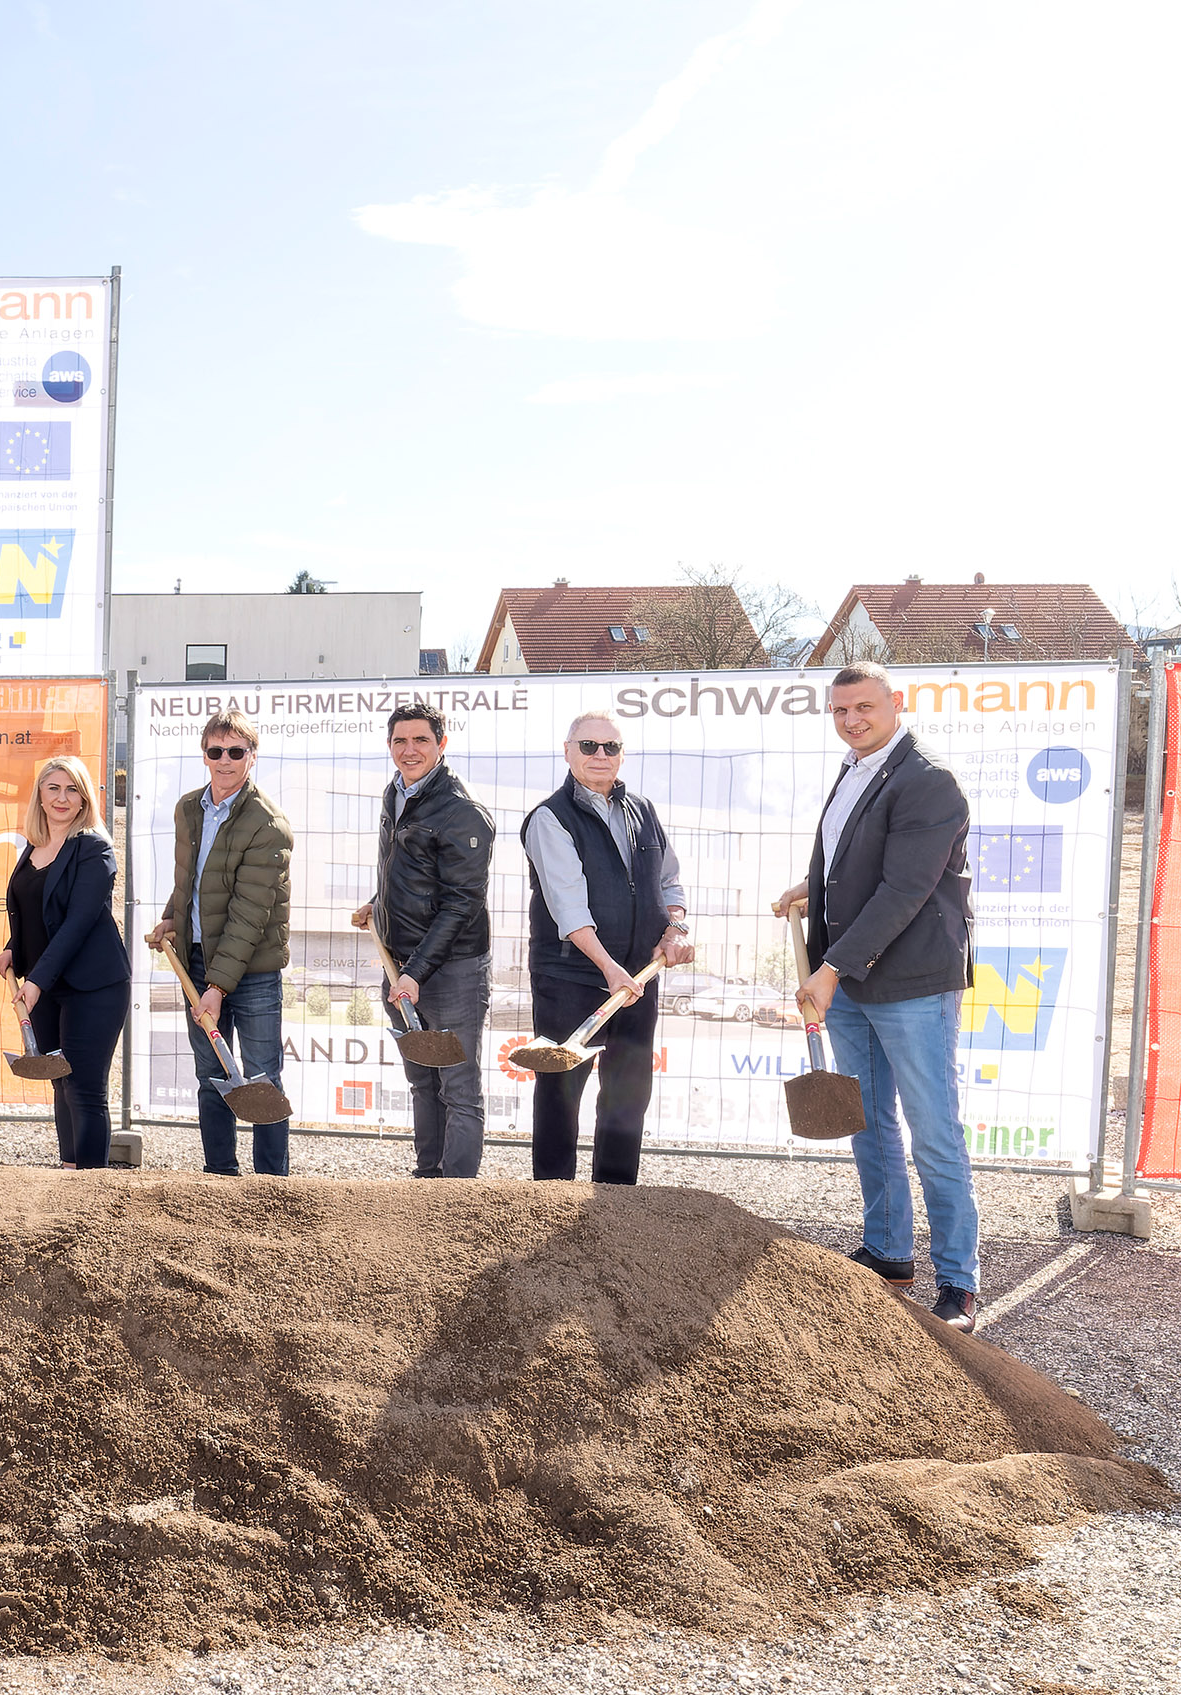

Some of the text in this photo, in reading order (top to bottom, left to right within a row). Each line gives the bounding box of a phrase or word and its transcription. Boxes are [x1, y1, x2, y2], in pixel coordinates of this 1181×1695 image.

[19, 326, 94, 341] Anlagen
[48, 369, 85, 383] aws
[62, 490, 77, 499] der
[48, 503, 77, 511] Union
[150, 695, 261, 718] NEUBAU
[149, 723, 204, 737] Nachha
[999, 721, 1096, 736] Anlagen
[965, 752, 1019, 764] austria
[958, 769, 1019, 782] schafts
[1036, 767, 1081, 782] aws
[974, 904, 1017, 913] anziert
[1049, 904, 1070, 913] der
[1032, 917, 1070, 927] Union
[283, 1036, 395, 1066] ANDL
[156, 1086, 193, 1099] EBN
